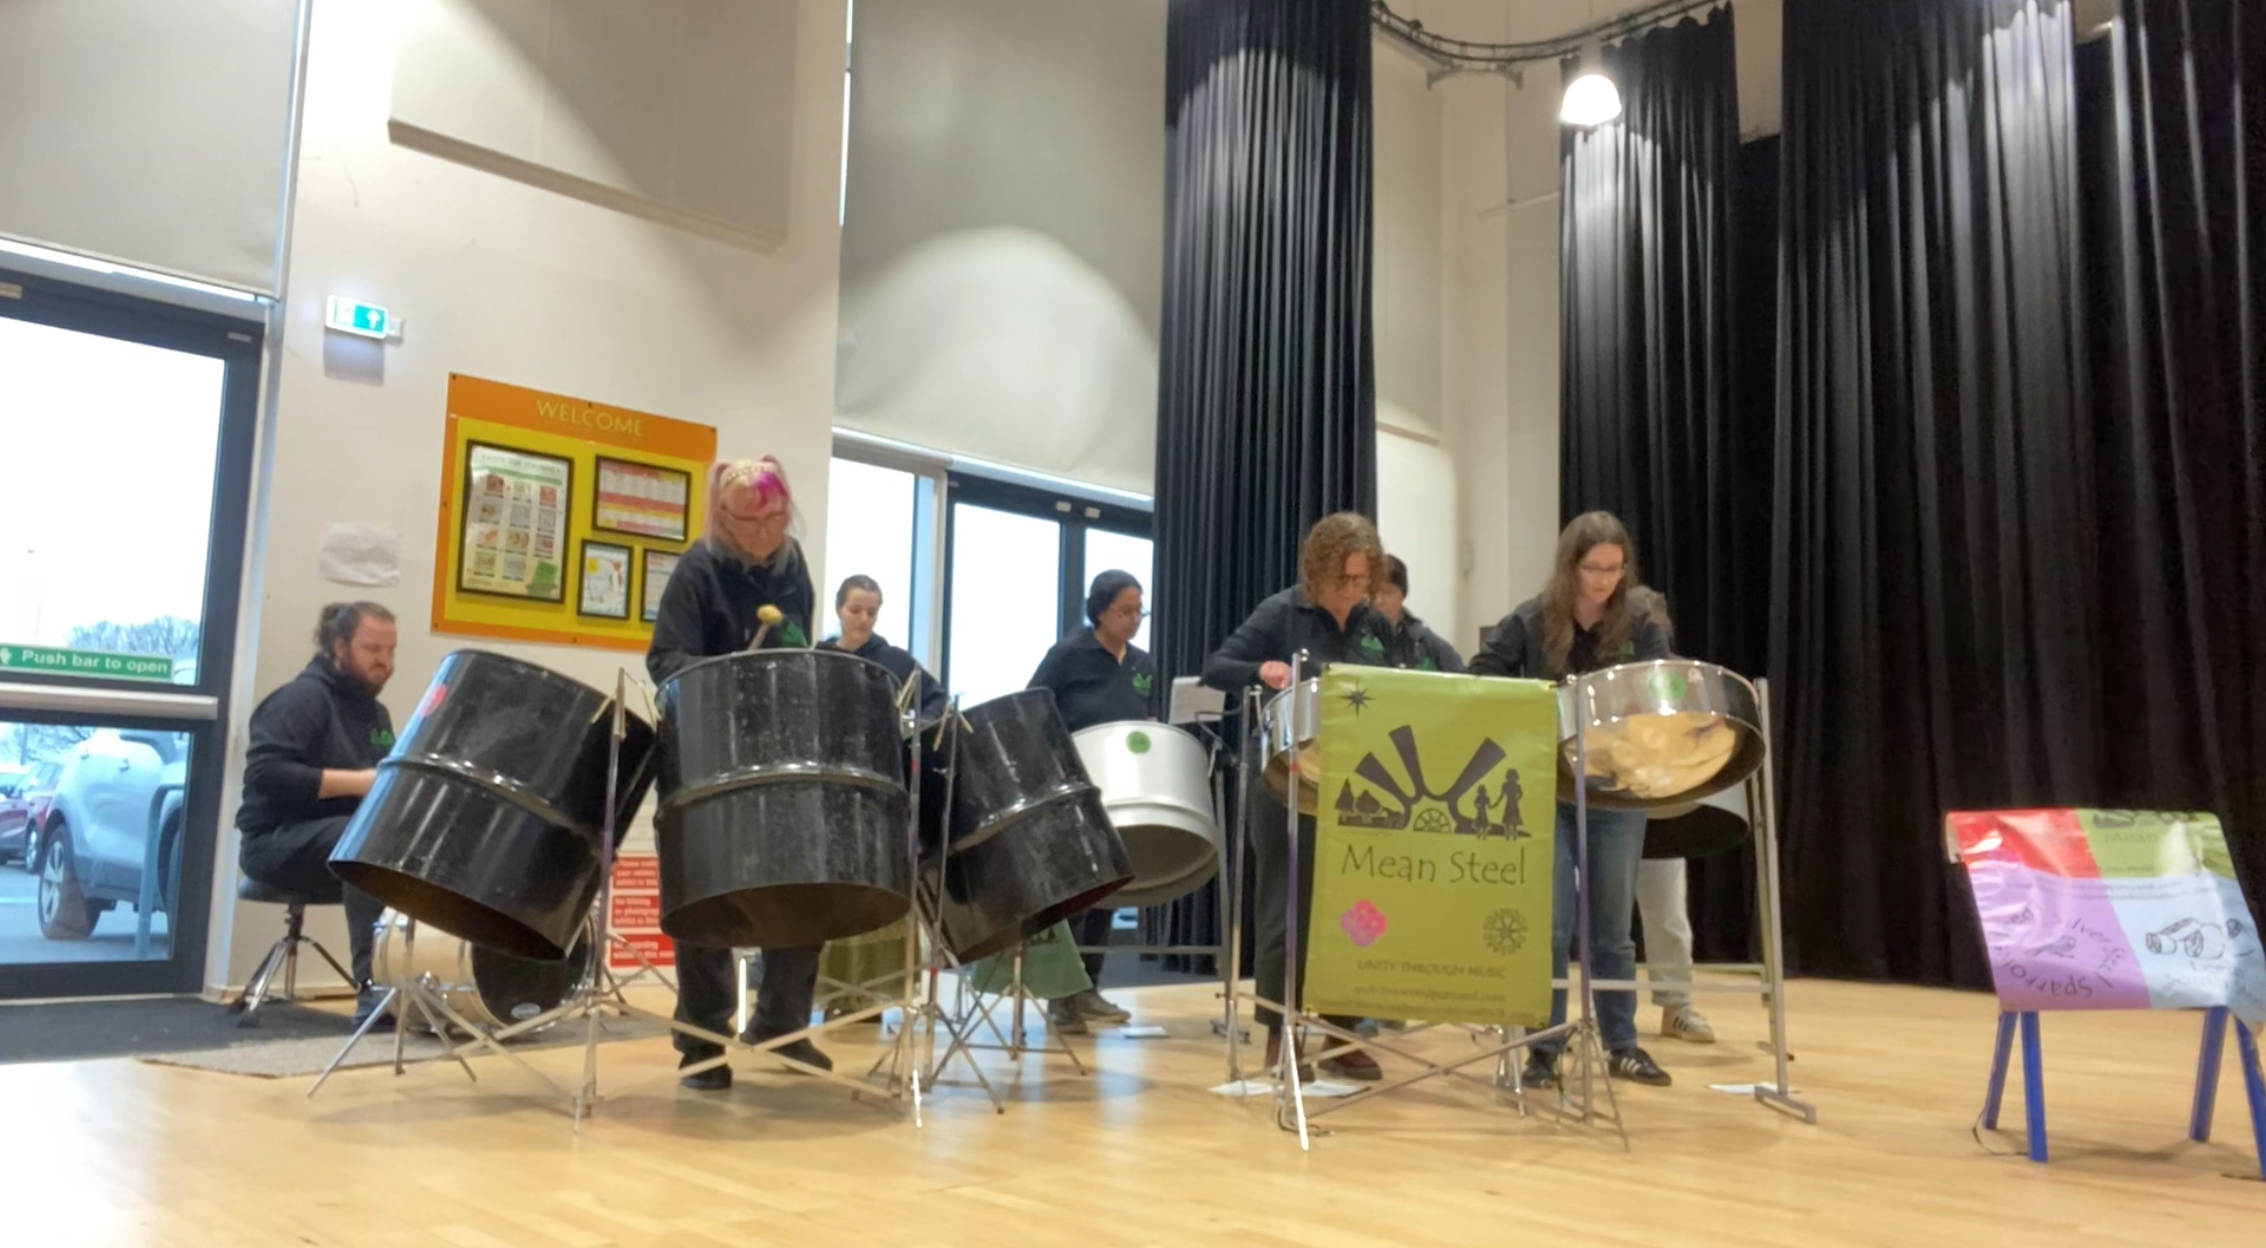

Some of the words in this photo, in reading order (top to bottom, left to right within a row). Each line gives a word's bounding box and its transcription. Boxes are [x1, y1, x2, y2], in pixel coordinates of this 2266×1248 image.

[536, 399, 643, 437] WELCOME
[22, 649, 67, 666] Push
[72, 654, 99, 668] bar
[105, 657, 122, 669] to
[126, 659, 168, 674] open
[1341, 844, 1436, 883] Mean
[1450, 846, 1525, 885] Steel
[1357, 959, 1396, 972] UNITY
[1401, 961, 1465, 976] THROUGH
[1467, 965, 1507, 979] MUSIC
